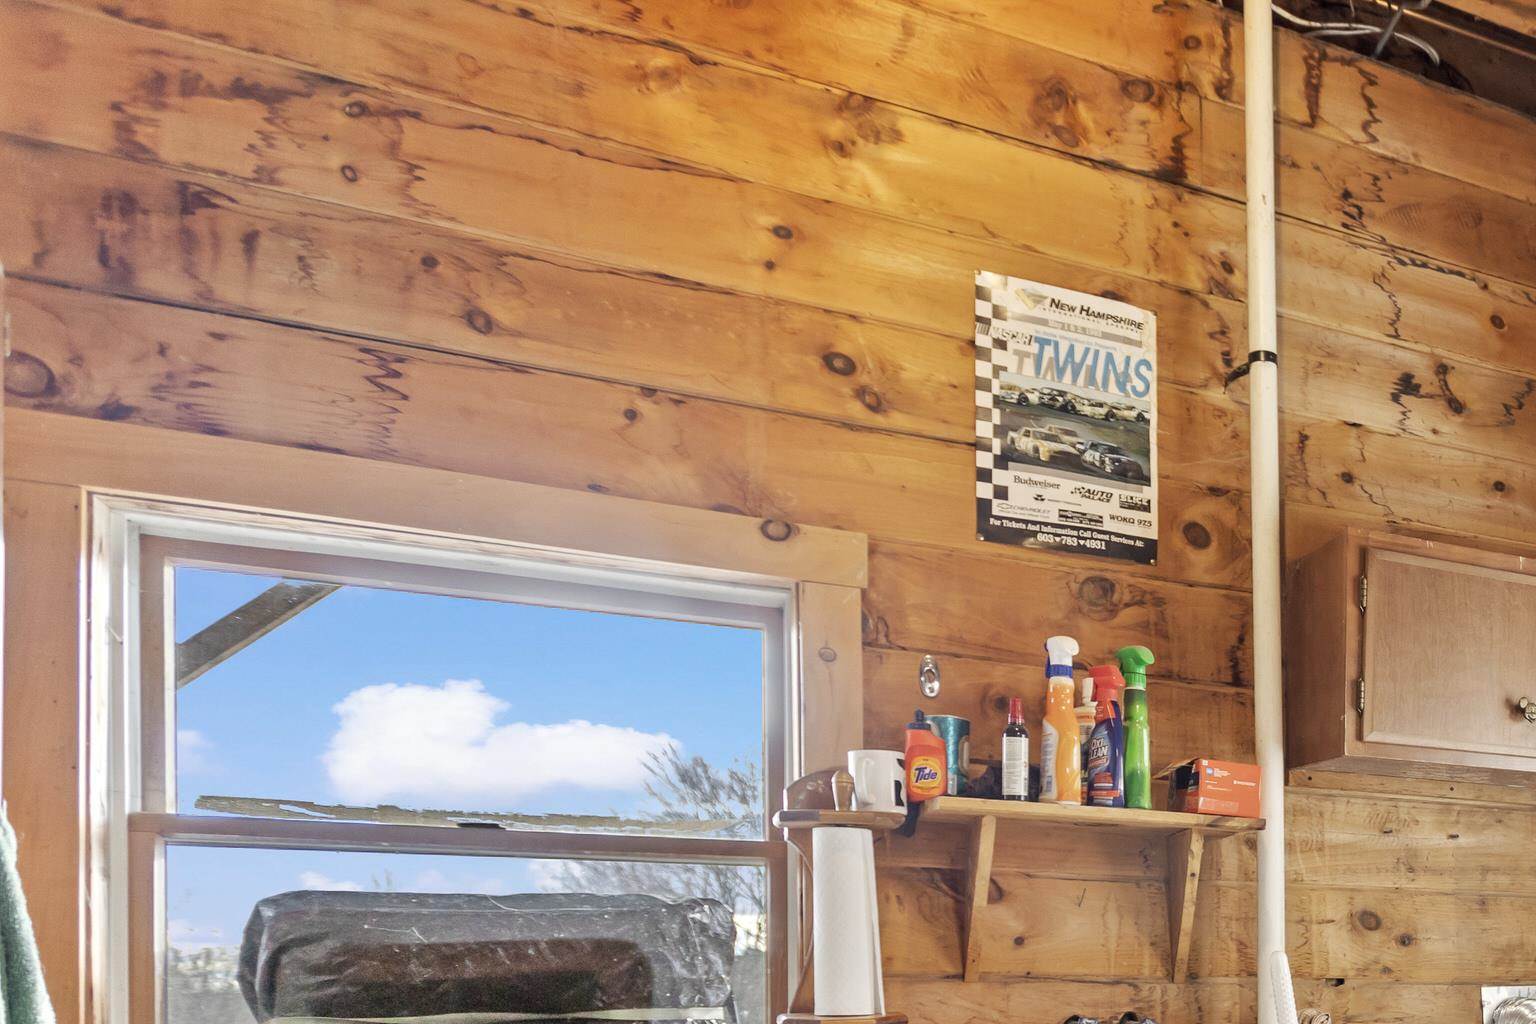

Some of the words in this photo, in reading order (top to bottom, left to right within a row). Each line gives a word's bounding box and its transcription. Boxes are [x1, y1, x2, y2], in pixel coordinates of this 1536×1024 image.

[1050, 298, 1078, 312] NEW
[1079, 304, 1145, 331] HAMPSHIRE
[1033, 336, 1153, 398] TWINS
[1013, 474, 1061, 491] Budweiser
[1084, 488, 1113, 499] AUTO
[989, 517, 1002, 526] For
[1002, 520, 1027, 530] Tickets
[1027, 523, 1041, 532] And
[1041, 525, 1078, 537] Information
[1079, 530, 1092, 539] Call
[1092, 532, 1110, 541] Guest
[1110, 535, 1134, 546] Services
[1037, 533, 1054, 544] 603
[1061, 535, 1078, 547] 783
[1085, 538, 1107, 550] 4931
[914, 766, 938, 783] Tide
